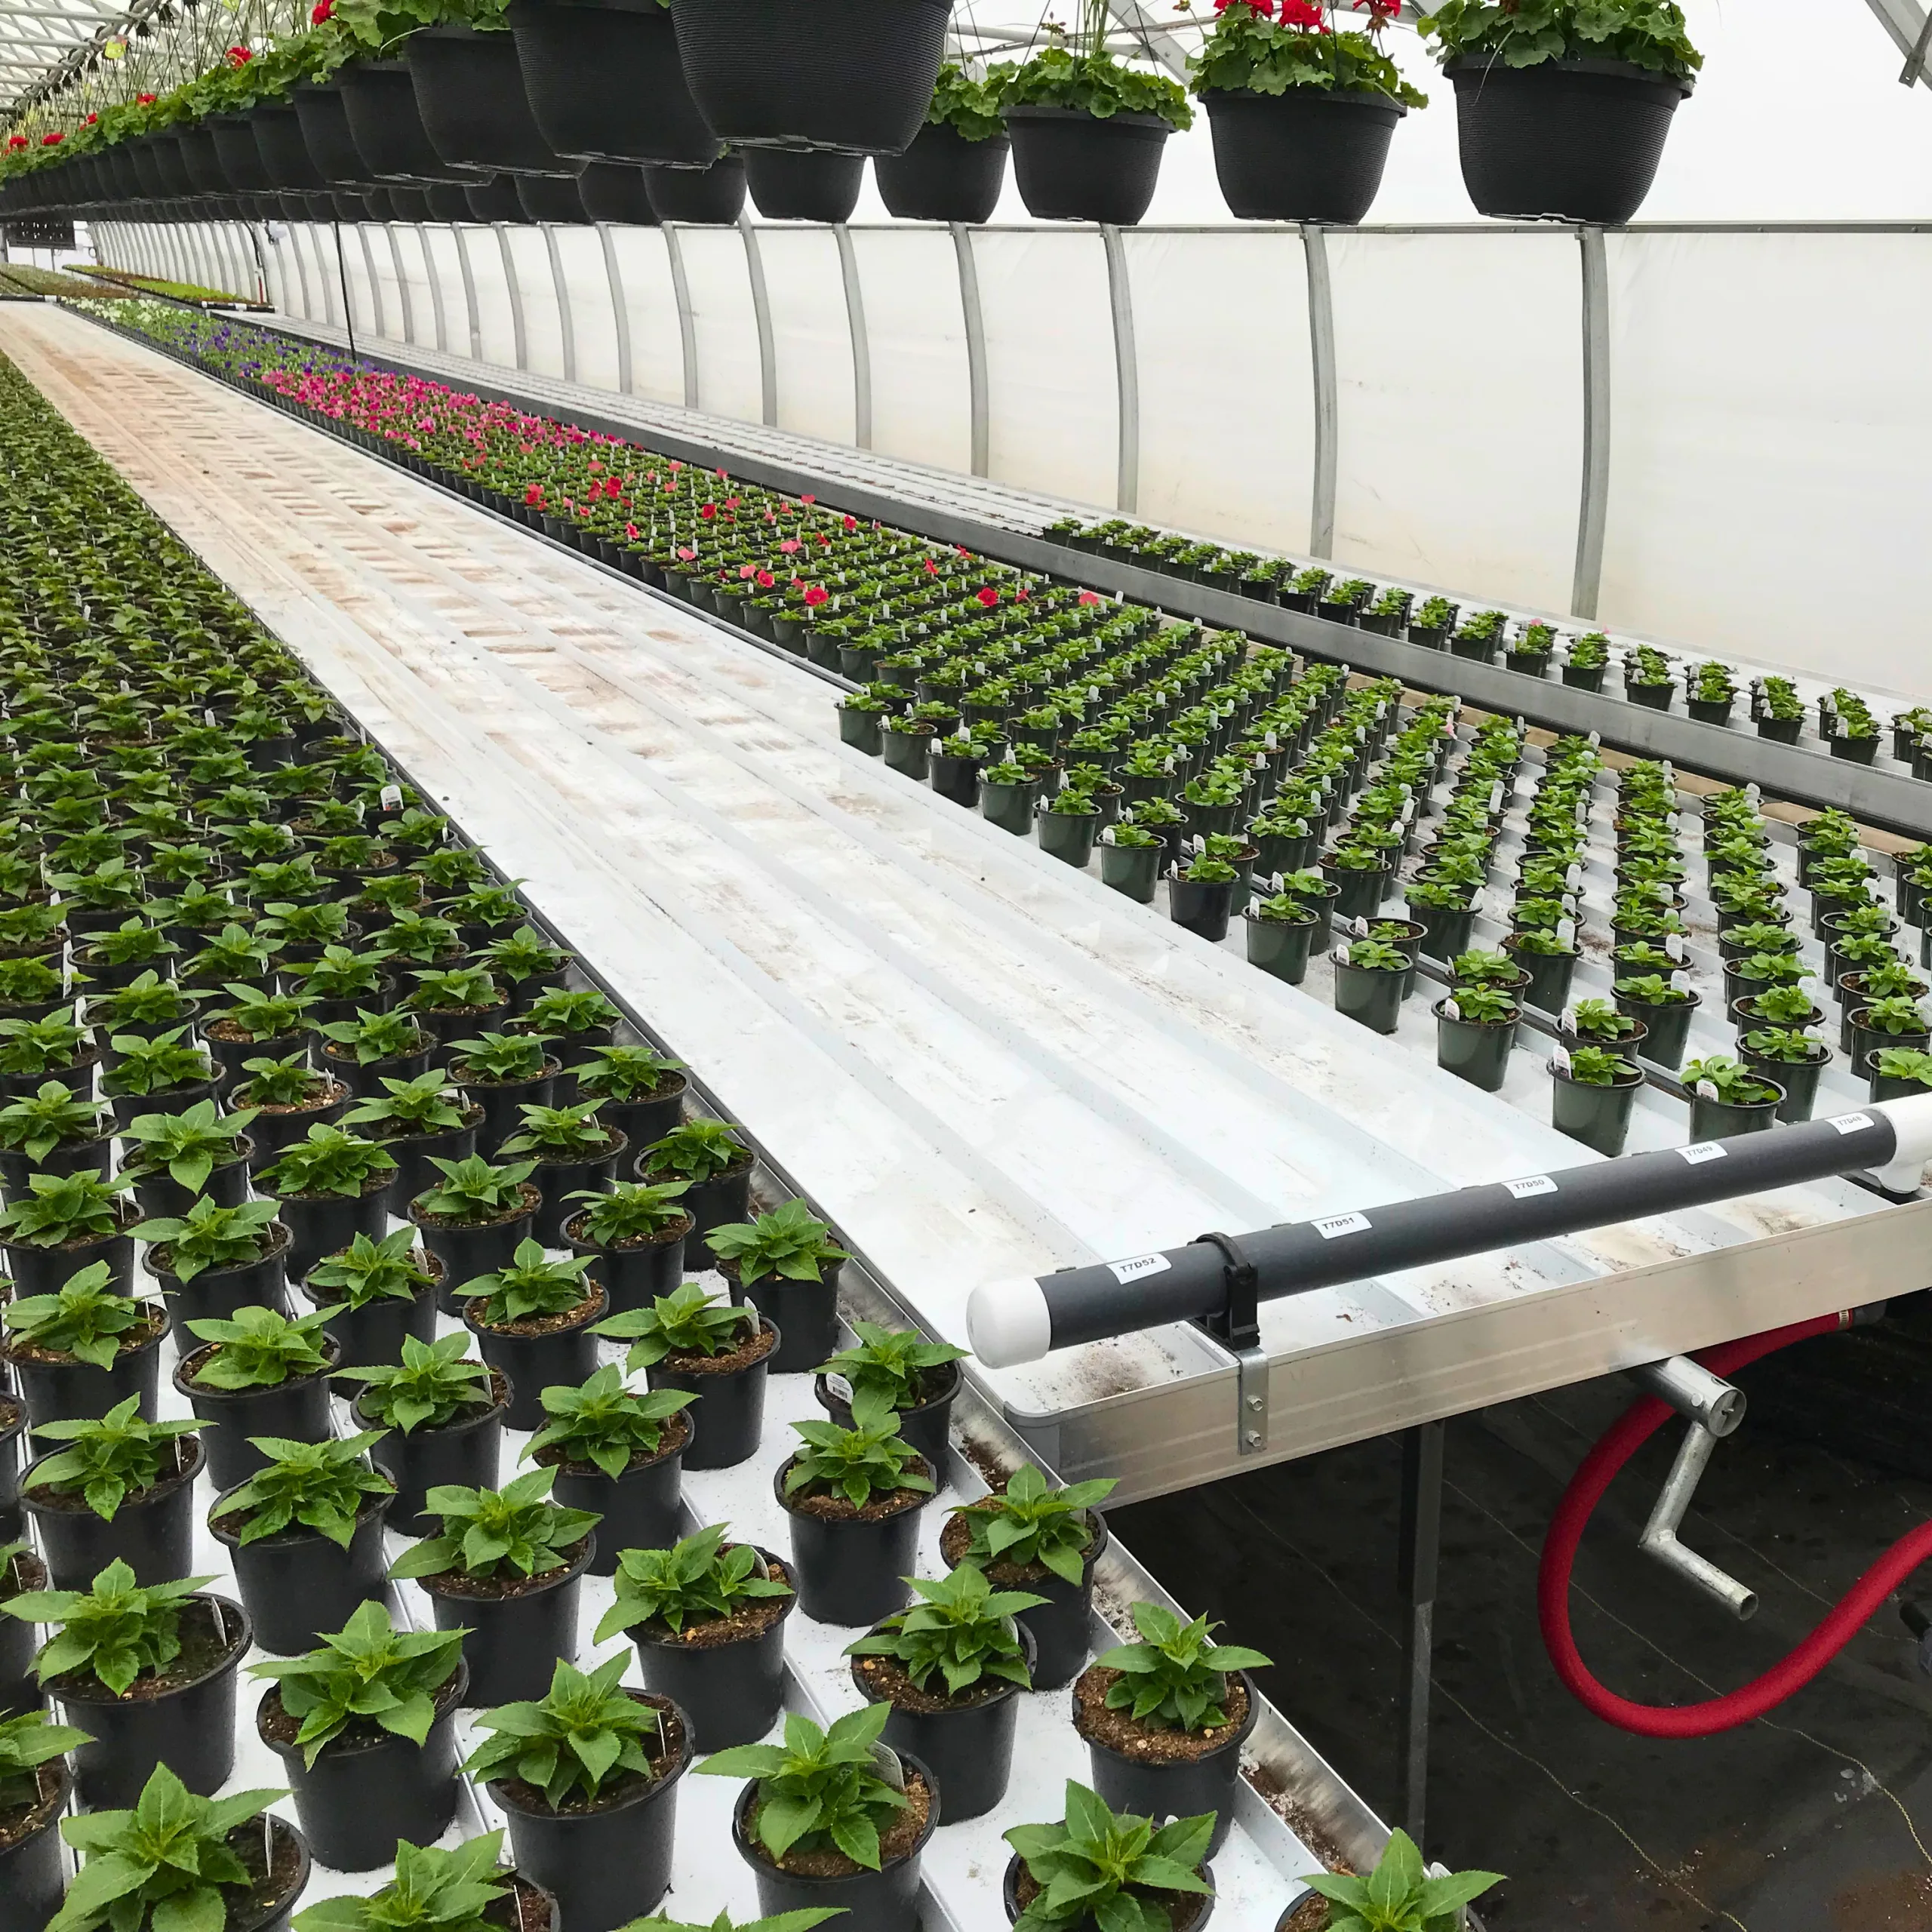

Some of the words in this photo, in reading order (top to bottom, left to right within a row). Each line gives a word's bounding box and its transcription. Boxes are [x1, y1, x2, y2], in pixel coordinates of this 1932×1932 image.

[1685, 1146, 1713, 1156] T7D49
[1513, 1179, 1545, 1190] T7D50
[1321, 1217, 1355, 1229] T7D51
[1119, 1257, 1157, 1273] T7D52
